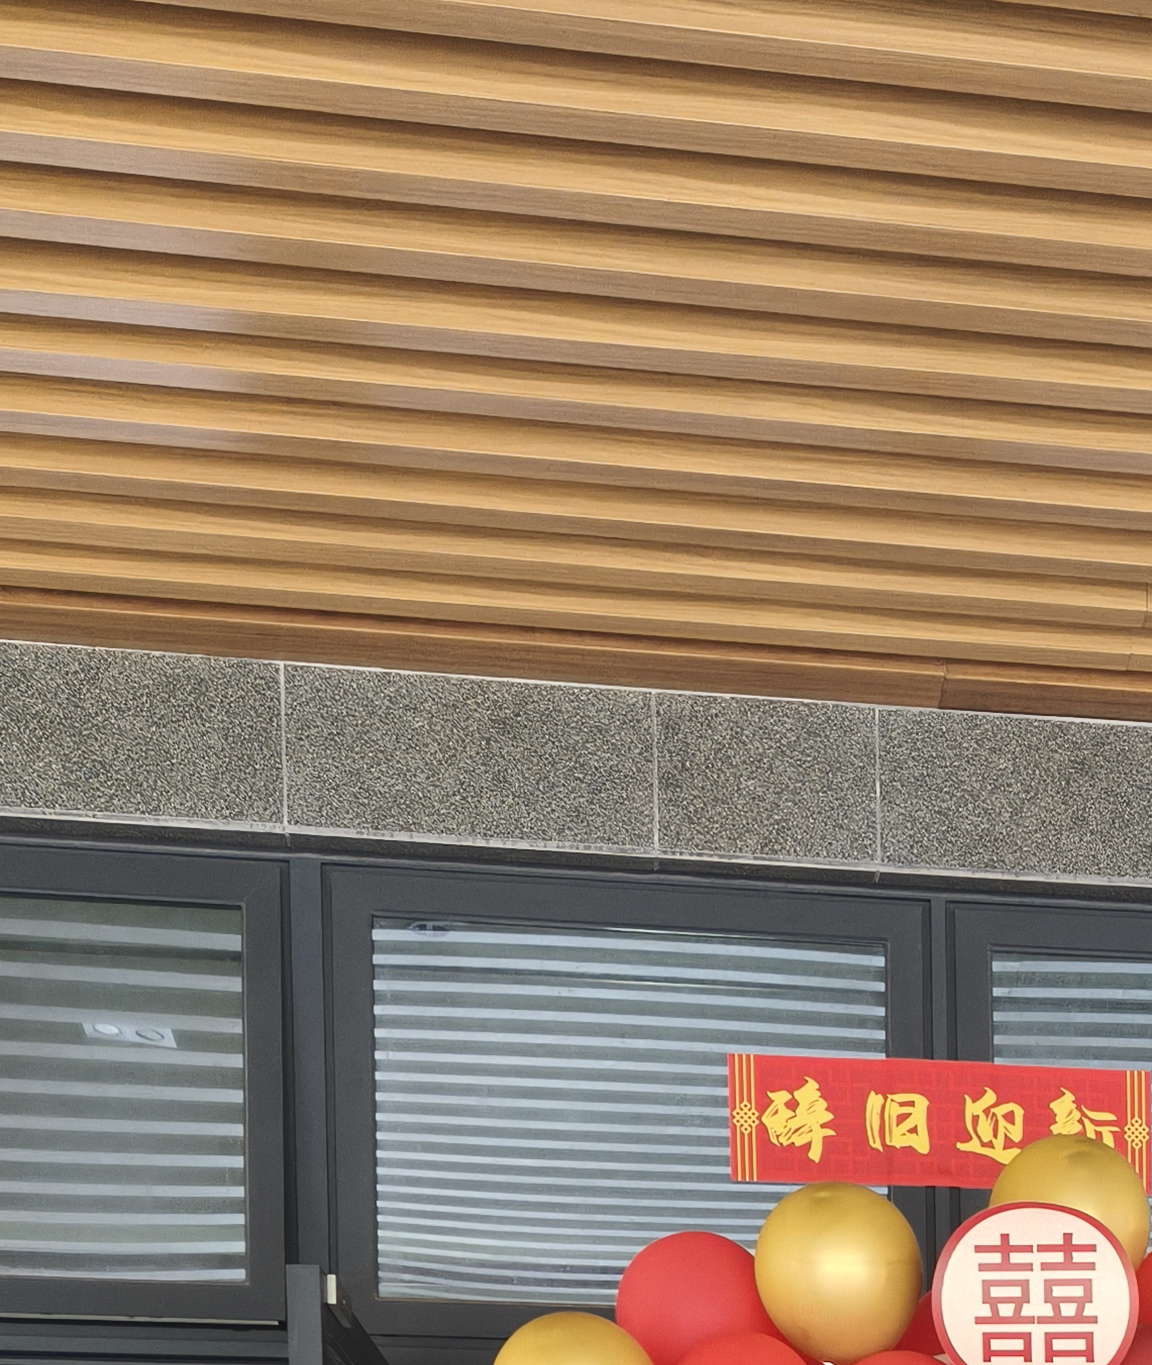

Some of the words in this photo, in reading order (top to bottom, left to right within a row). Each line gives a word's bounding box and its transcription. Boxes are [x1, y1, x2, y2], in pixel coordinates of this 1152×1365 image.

[761, 1076, 1120, 1164] 辞旧迎新
[974, 1232, 1098, 1363] 囍
